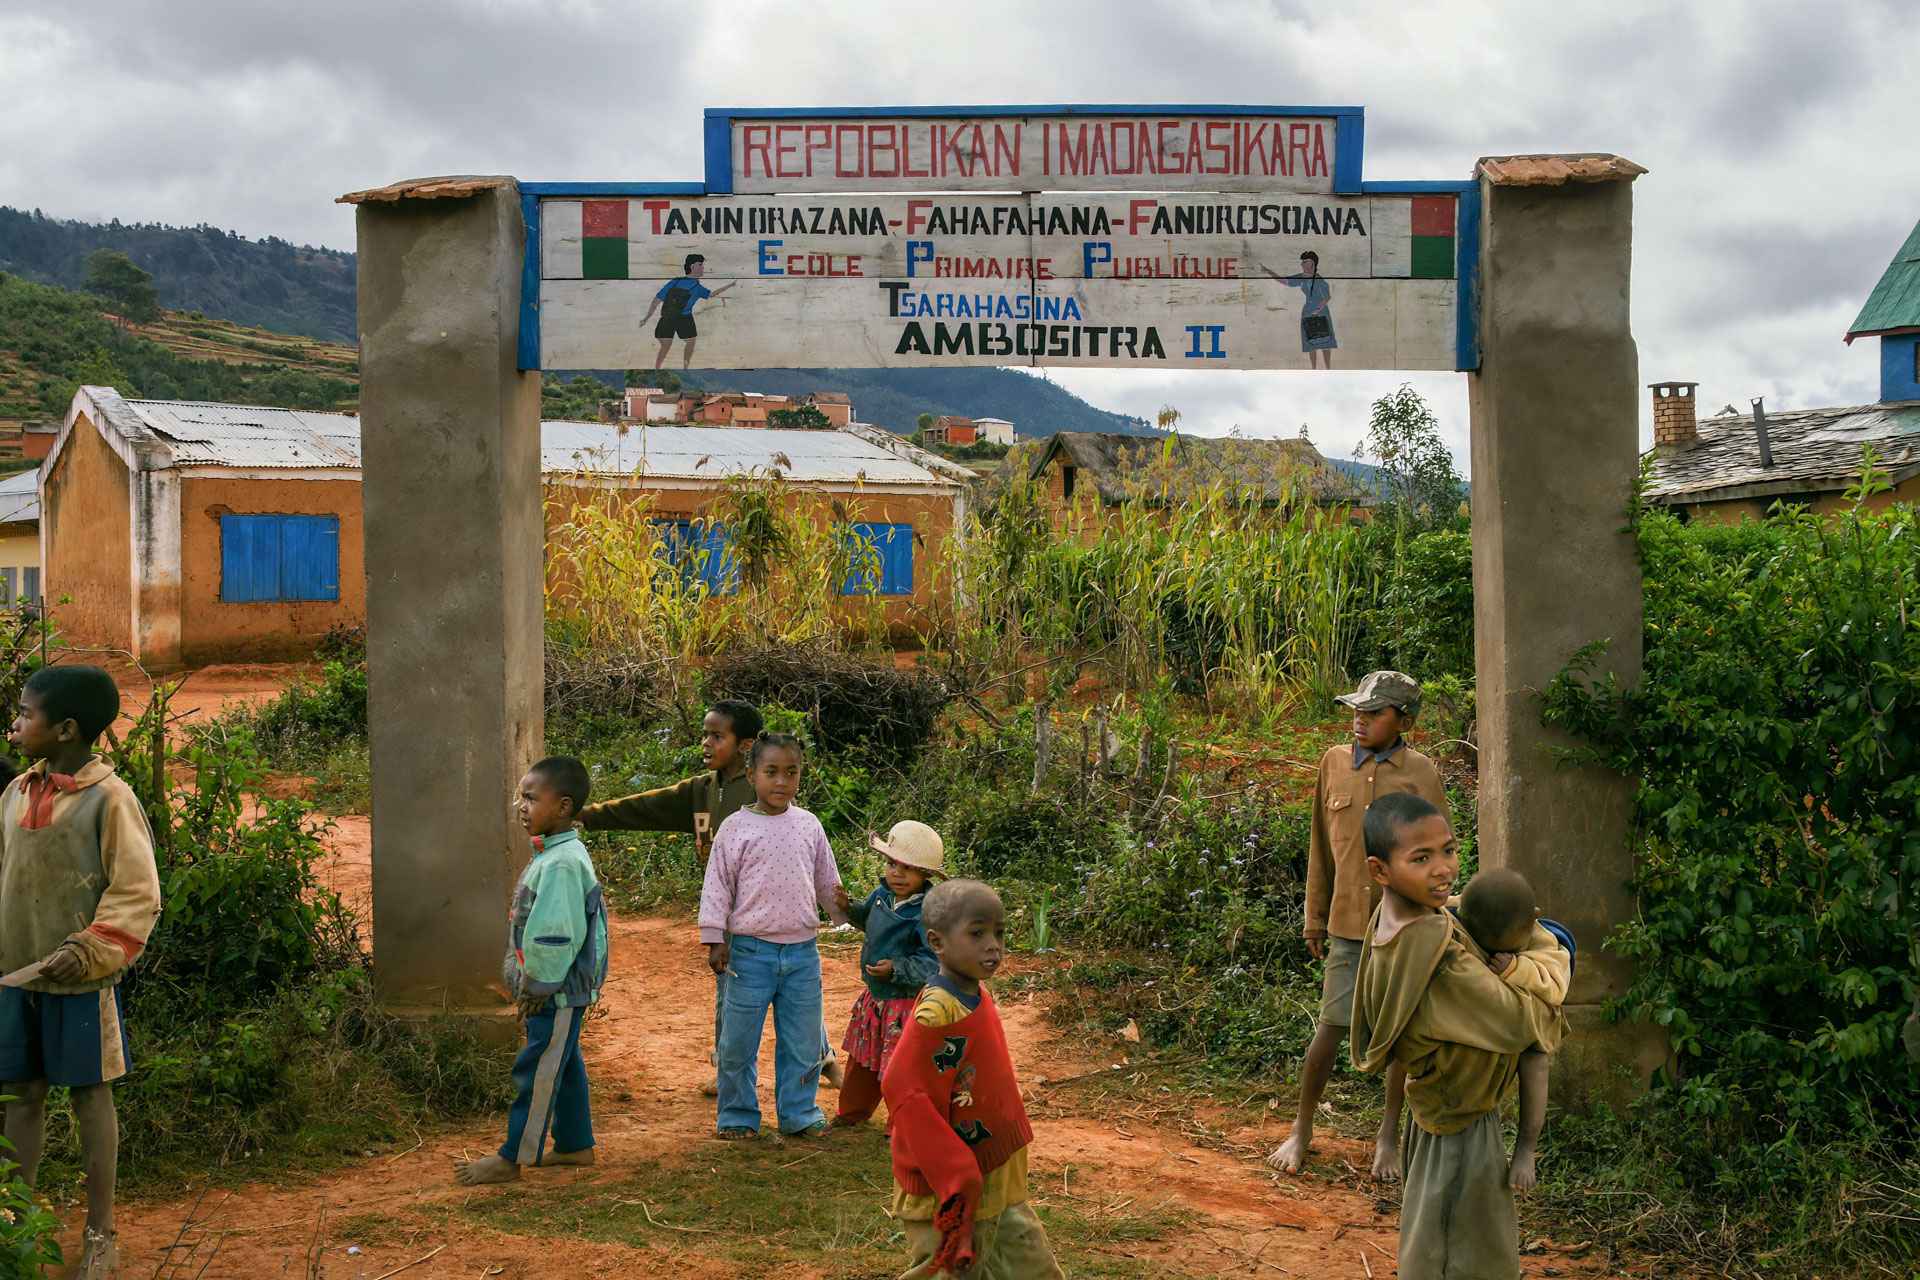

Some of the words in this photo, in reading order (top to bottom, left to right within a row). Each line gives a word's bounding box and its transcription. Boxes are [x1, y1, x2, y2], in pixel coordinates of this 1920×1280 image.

[743, 124, 1020, 178] REPOBLIKAN
[758, 240, 863, 277] ECOLE
[906, 241, 1054, 280] PRIMAIRE
[1083, 241, 1239, 280] PUBLIQUE
[879, 282, 1082, 321] TSARAHASINA
[895, 321, 1167, 359] AMBOSITRA
[1185, 325, 1226, 359] II
